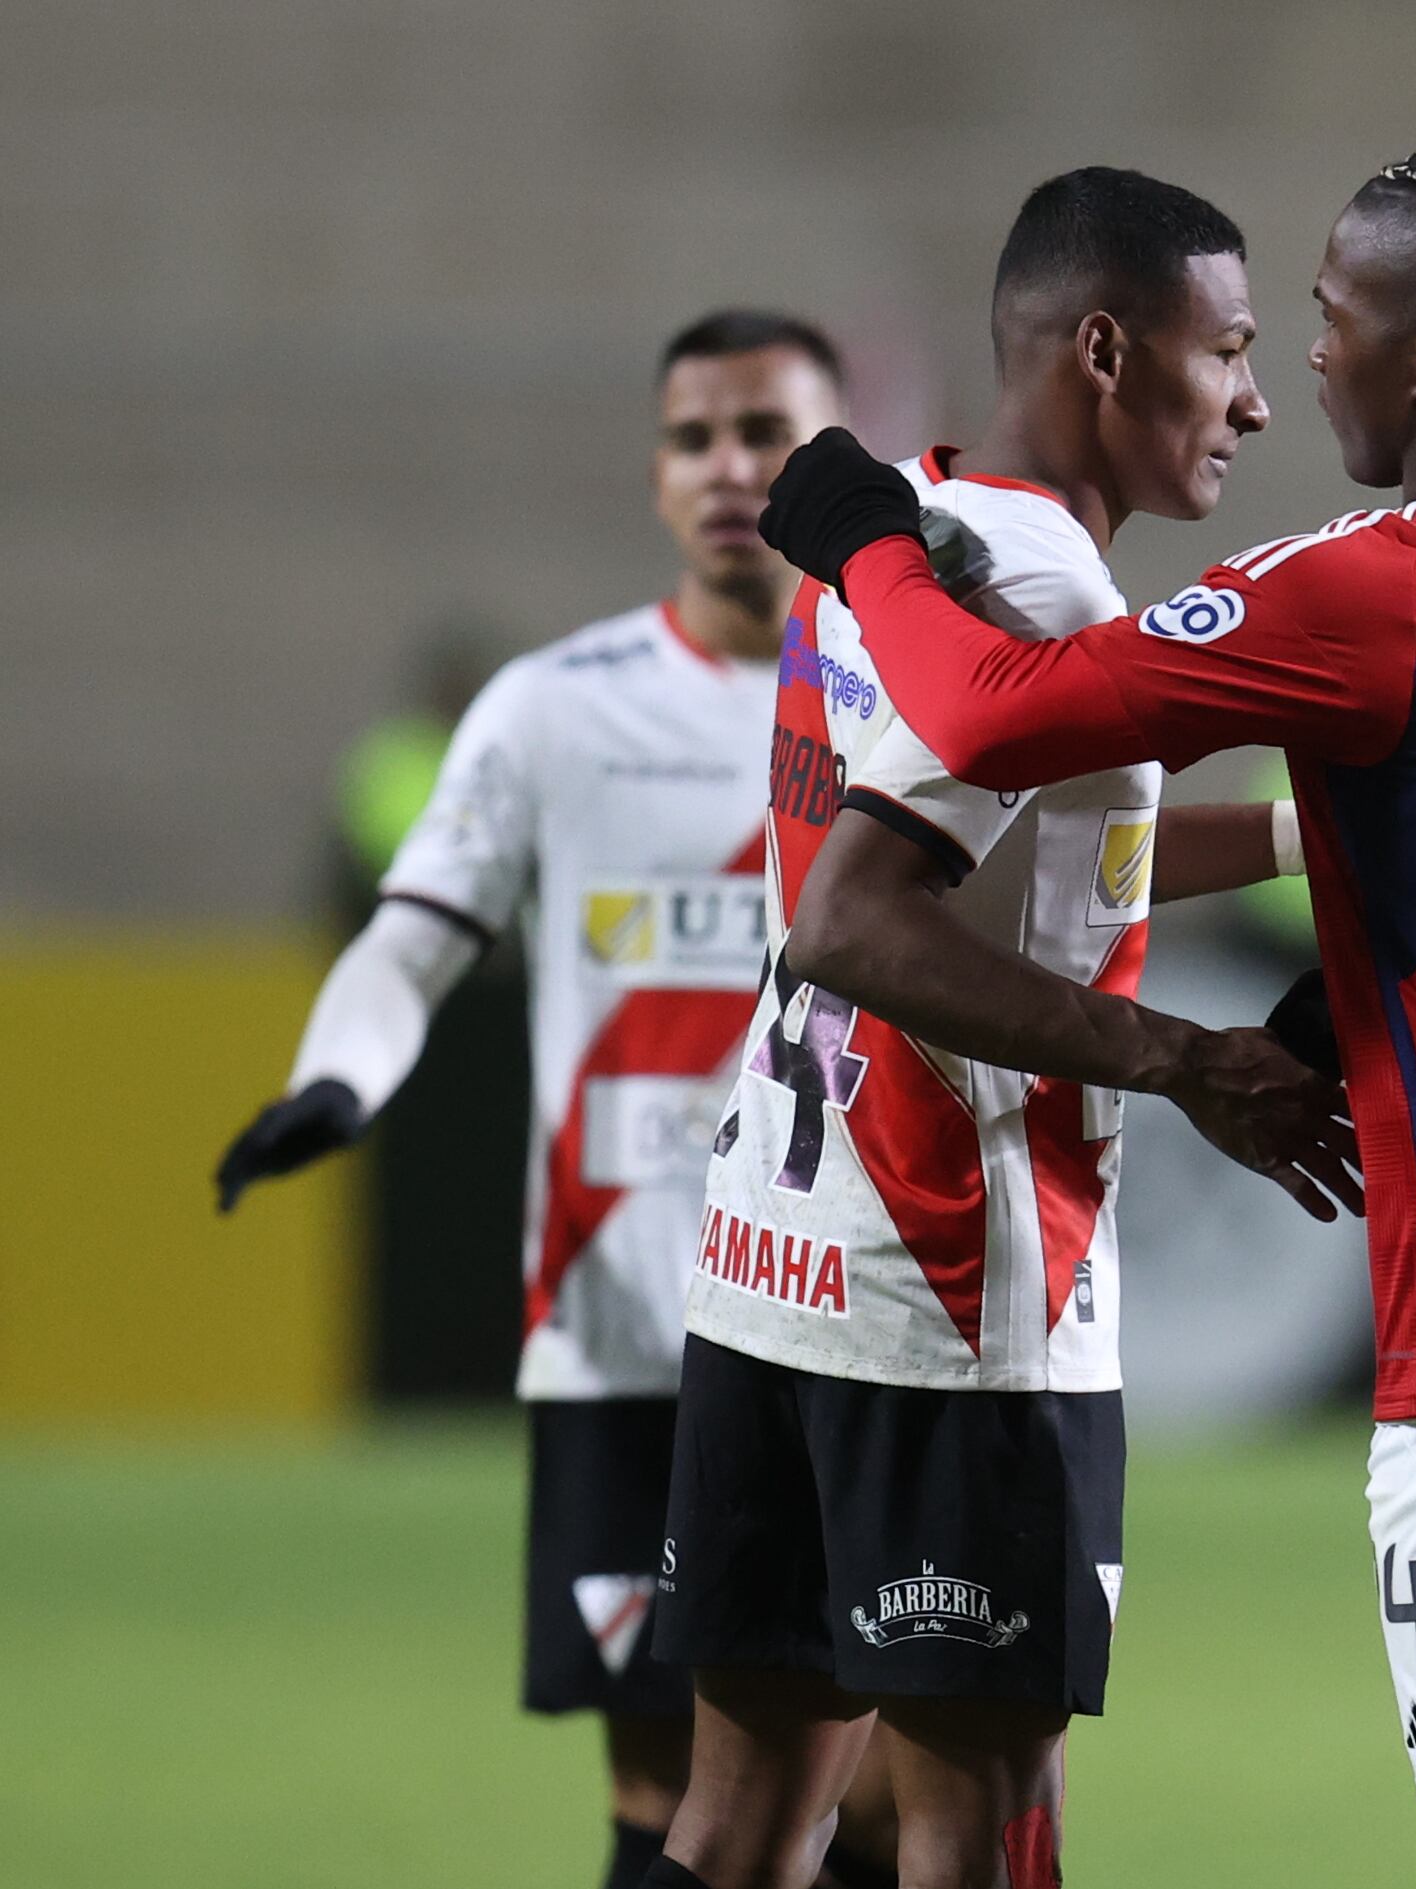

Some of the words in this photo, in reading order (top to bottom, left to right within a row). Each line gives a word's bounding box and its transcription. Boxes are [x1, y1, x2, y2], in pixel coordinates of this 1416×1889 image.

[713, 932, 869, 1200] 4
[922, 1558, 935, 1576] La
[878, 1581, 993, 1625] BARBERIA
[913, 1619, 927, 1633] La
